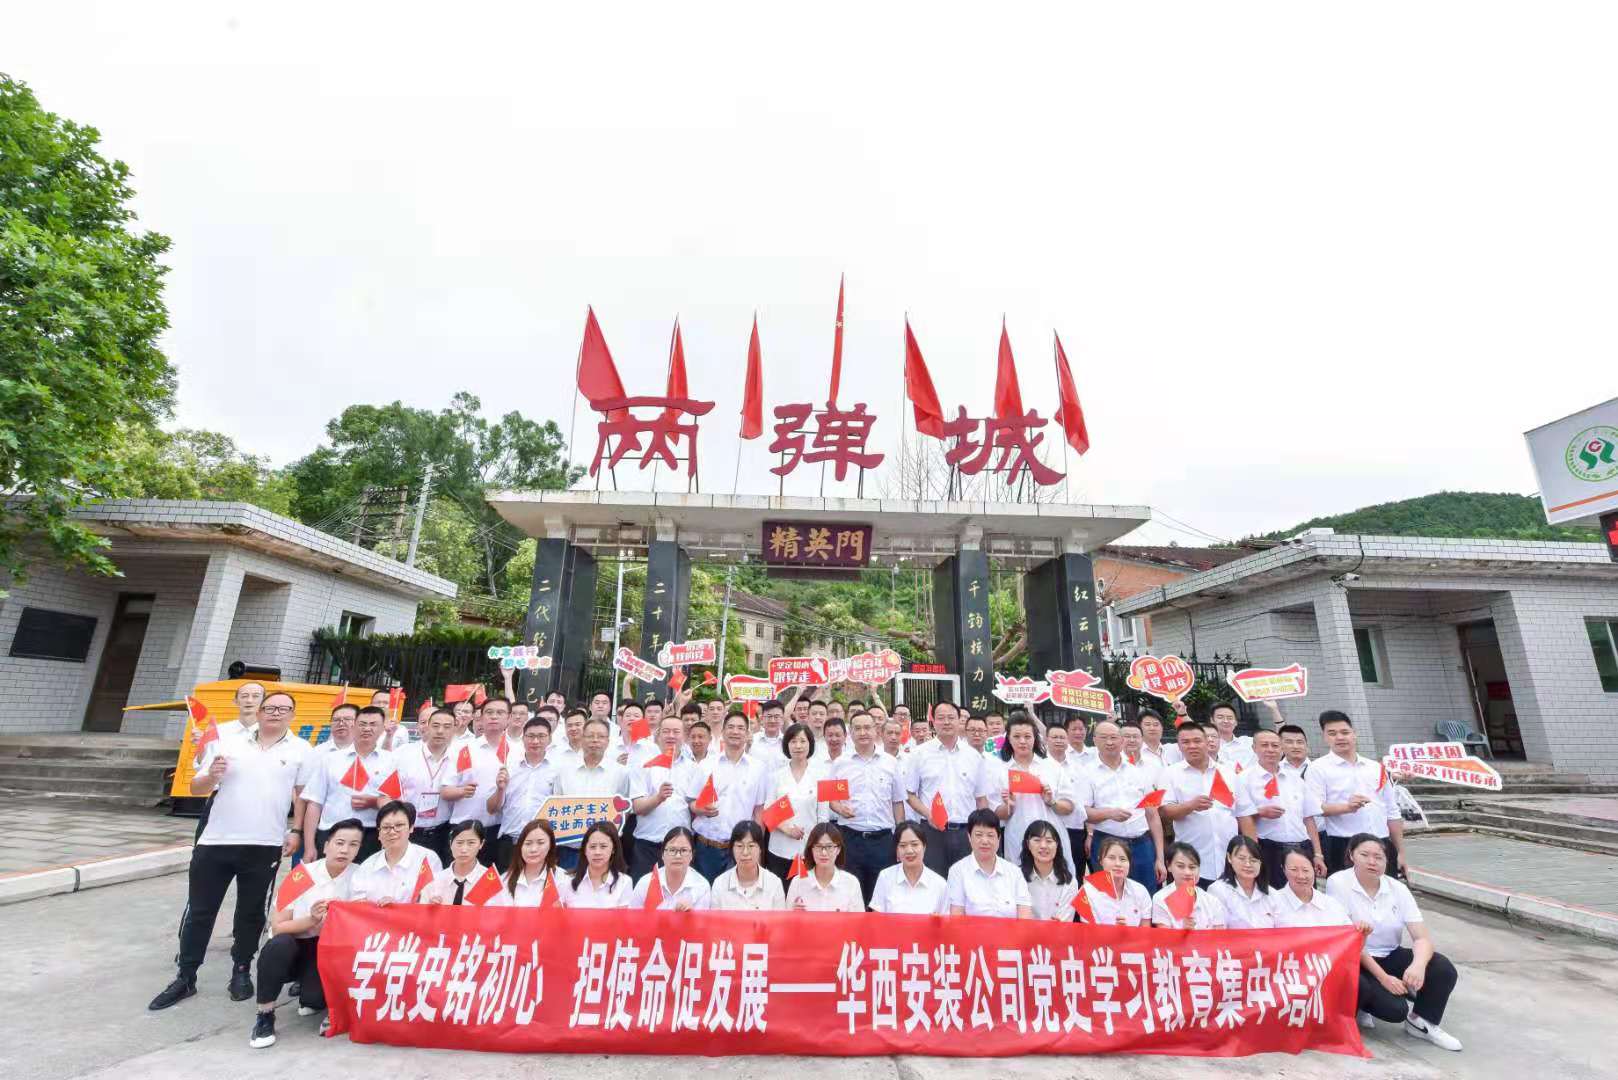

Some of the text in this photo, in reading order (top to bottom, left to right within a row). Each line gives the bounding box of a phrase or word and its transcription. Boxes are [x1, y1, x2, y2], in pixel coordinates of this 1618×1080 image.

[590, 397, 1066, 486] 两弹城
[769, 526, 865, 561] 精英門
[1161, 660, 1187, 677] 100
[1393, 745, 1463, 760] 红色基因
[548, 803, 609, 818] 为共产主义
[349, 932, 544, 1026] 学党史铭初心
